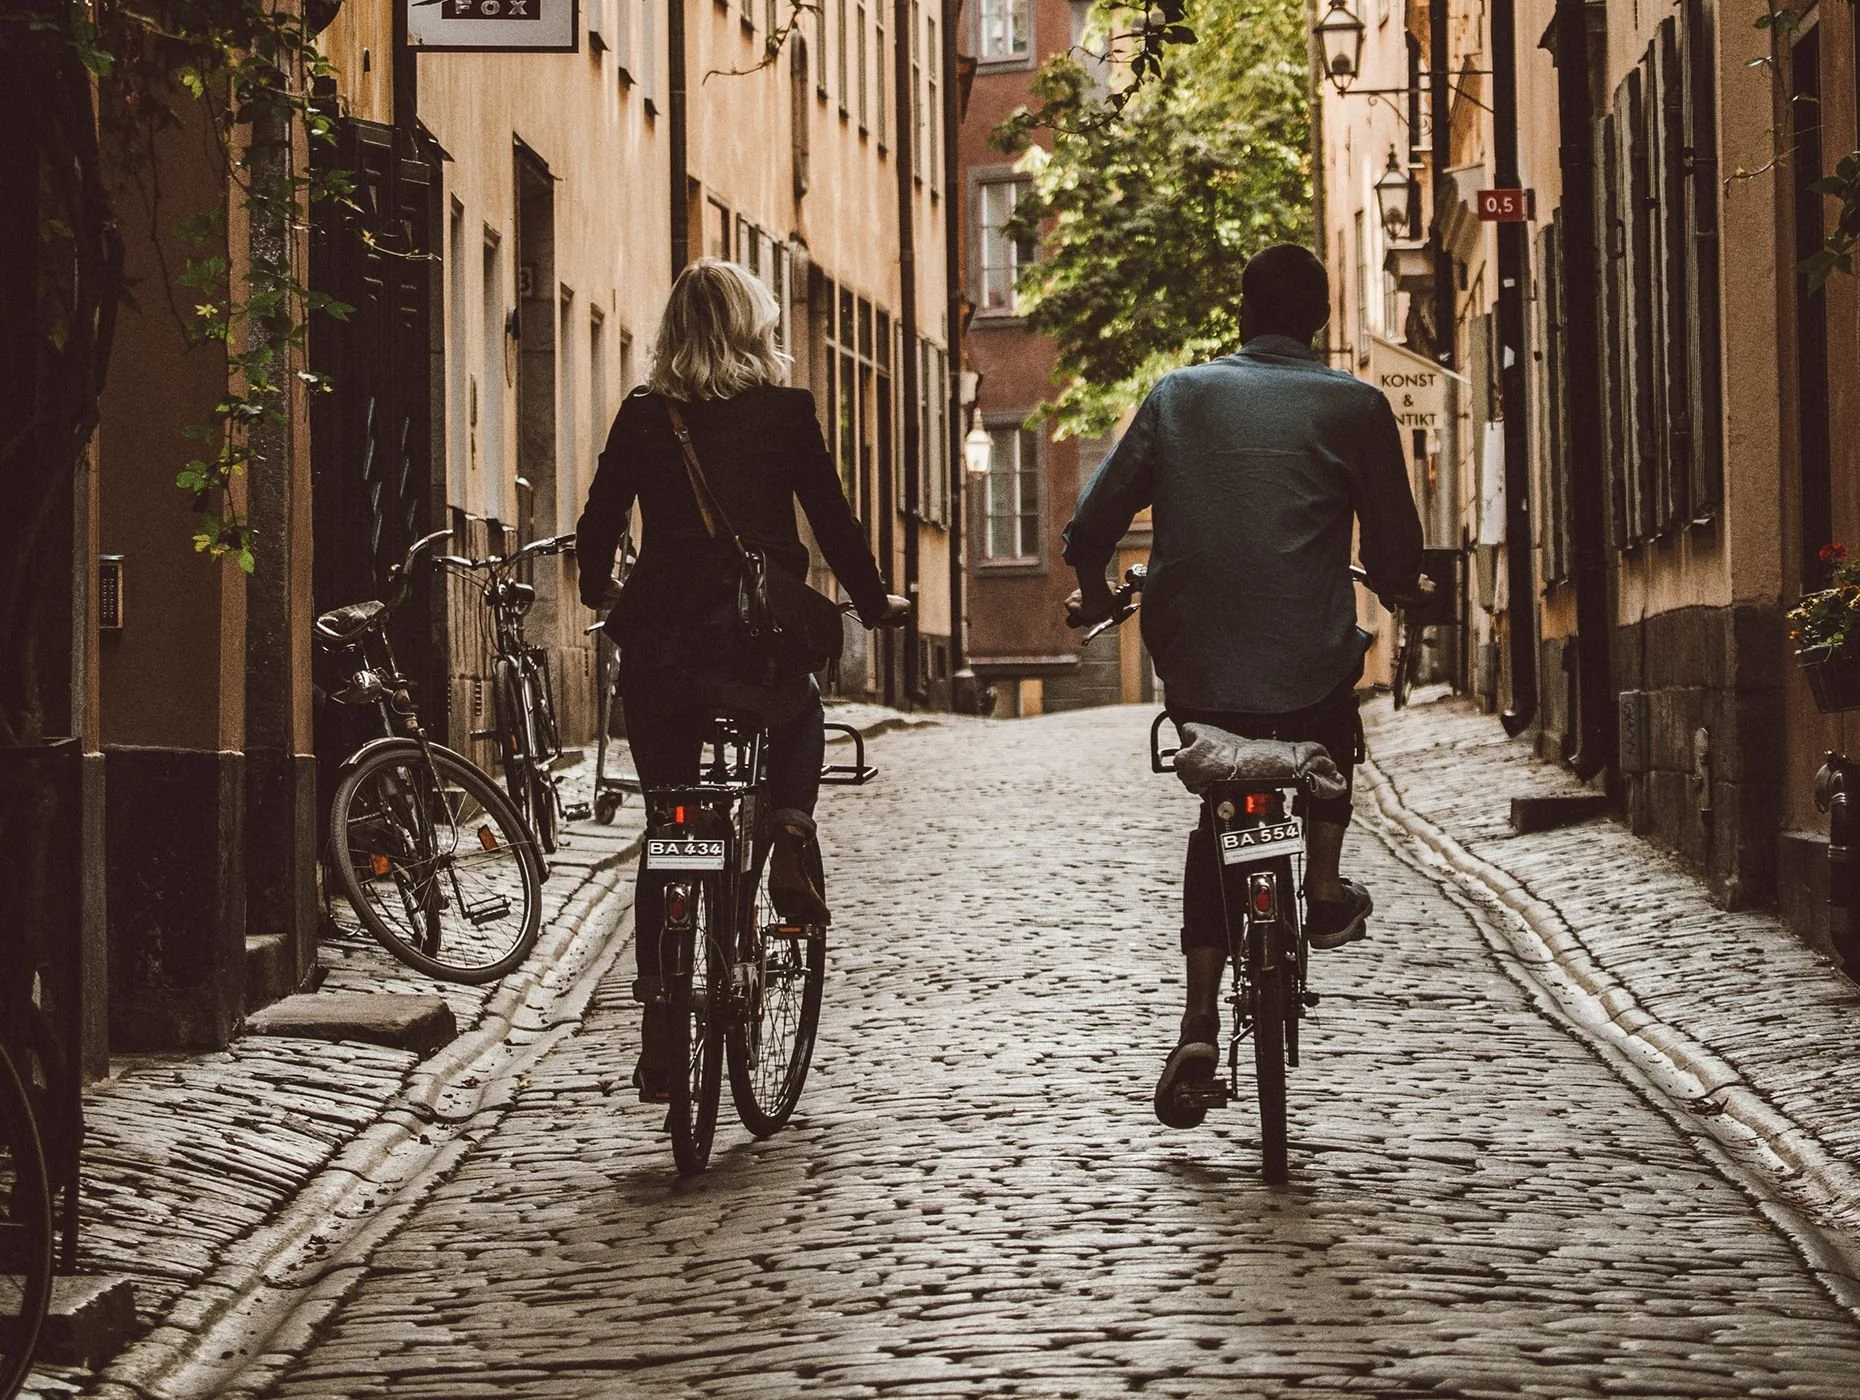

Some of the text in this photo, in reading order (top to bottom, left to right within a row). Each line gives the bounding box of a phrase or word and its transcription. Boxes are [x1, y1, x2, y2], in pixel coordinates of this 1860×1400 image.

[455, 0, 528, 15] FOX
[1486, 197, 1513, 214] 0,5
[1381, 374, 1437, 387] KONST
[1403, 394, 1414, 407] &
[1395, 413, 1437, 426] NTIKT
[1223, 824, 1299, 849] BA 554
[650, 842, 721, 855] BA 434
